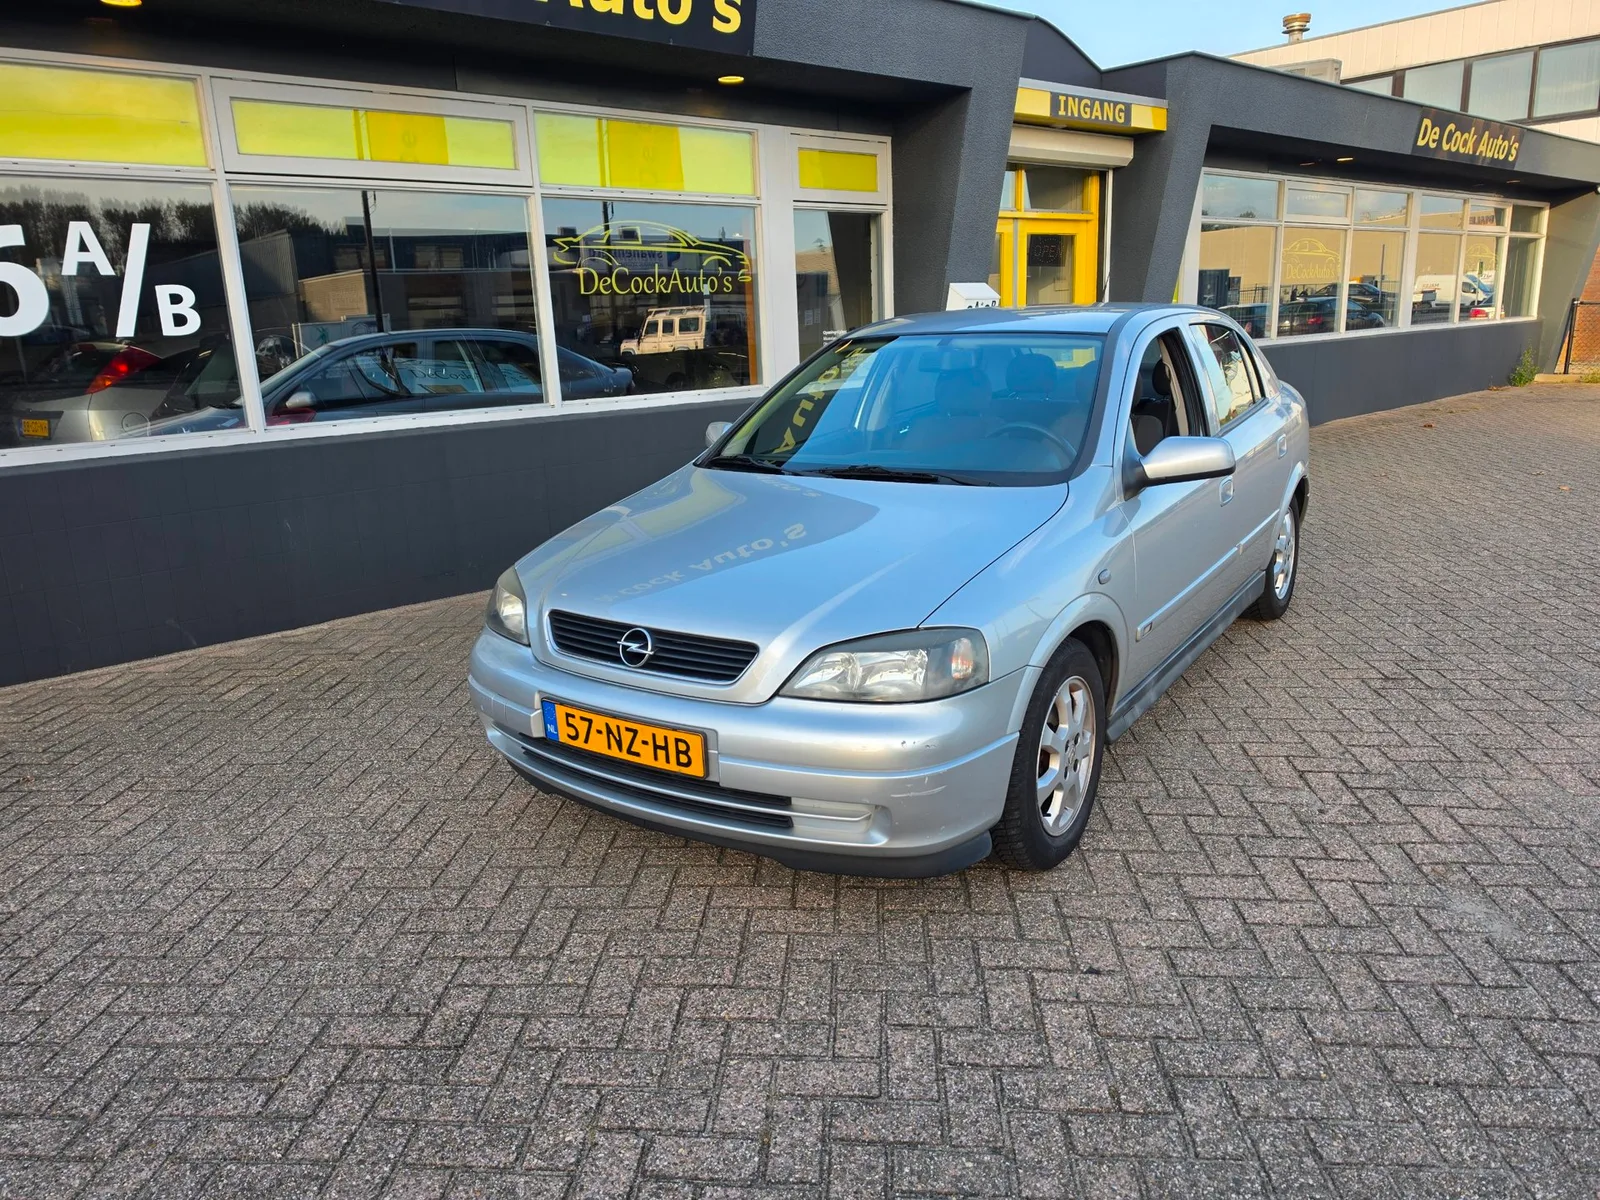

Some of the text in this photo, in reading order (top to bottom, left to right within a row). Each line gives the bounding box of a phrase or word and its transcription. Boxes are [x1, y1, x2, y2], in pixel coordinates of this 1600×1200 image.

[1058, 95, 1125, 124] INGANG
[1416, 118, 1519, 162] De Cock Auto's
[578, 263, 733, 296] DeCockAuto's
[547, 724, 558, 735] NL
[565, 711, 693, 768] 57-NZ-HB
